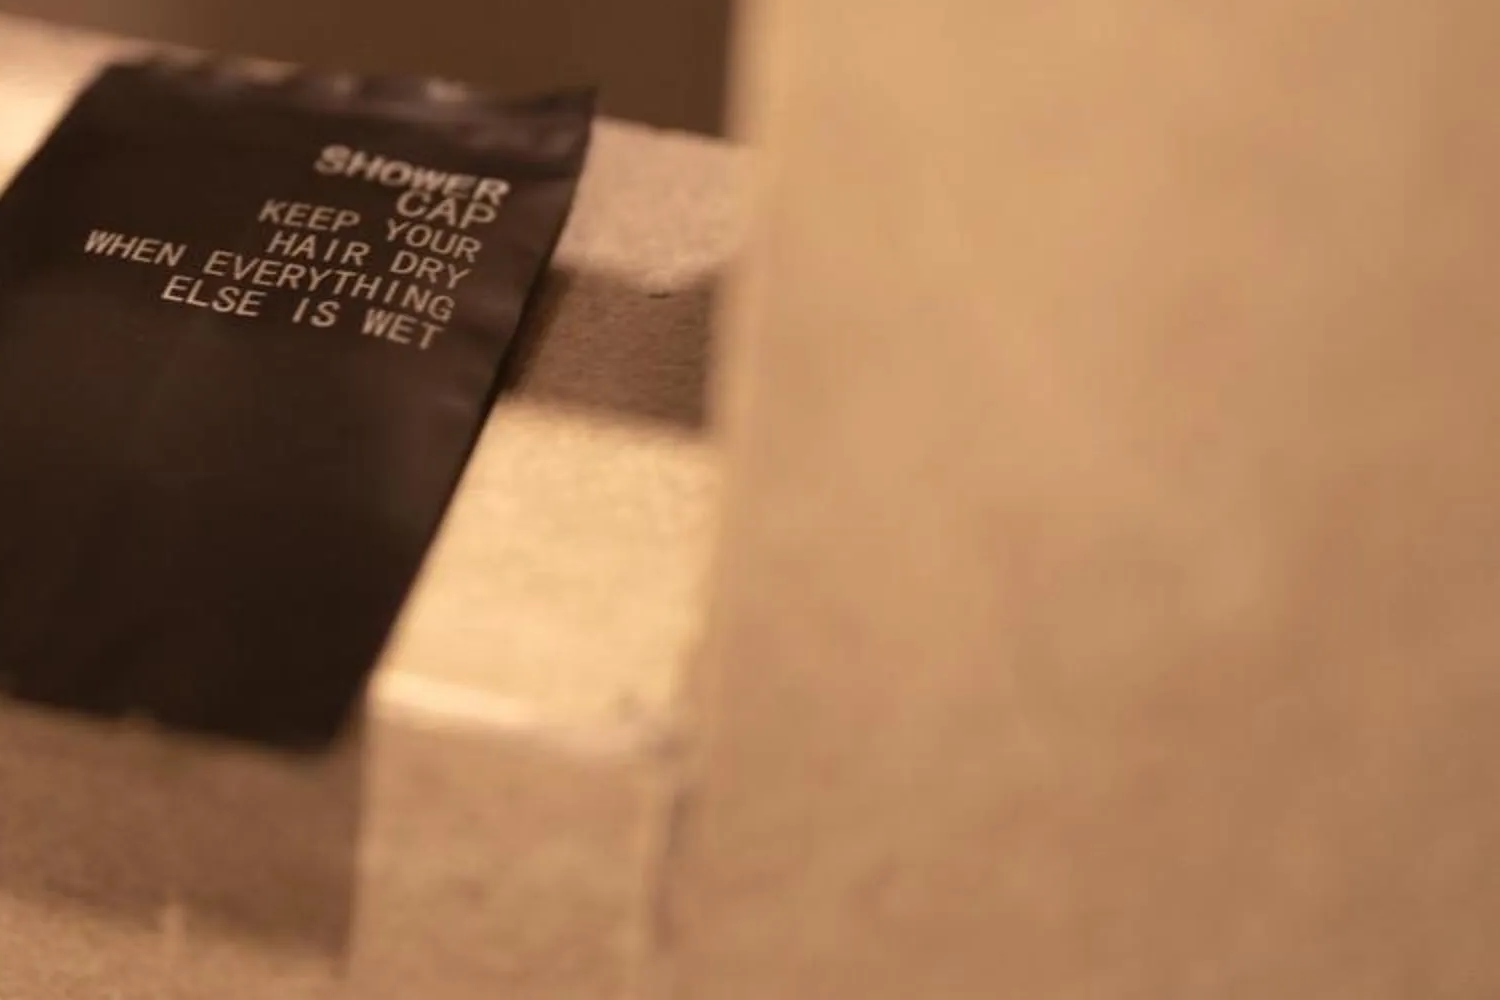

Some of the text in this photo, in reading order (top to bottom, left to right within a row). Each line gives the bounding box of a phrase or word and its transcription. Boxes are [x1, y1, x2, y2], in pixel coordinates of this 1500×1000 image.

[314, 145, 509, 206] SHOWER
[258, 200, 482, 263] KEEP YOUR
[397, 191, 497, 229] CAP
[84, 230, 456, 323] WHEN EVERYTHING
[267, 231, 472, 290] HAIR DRY
[161, 275, 446, 350] ELSE IS WET
